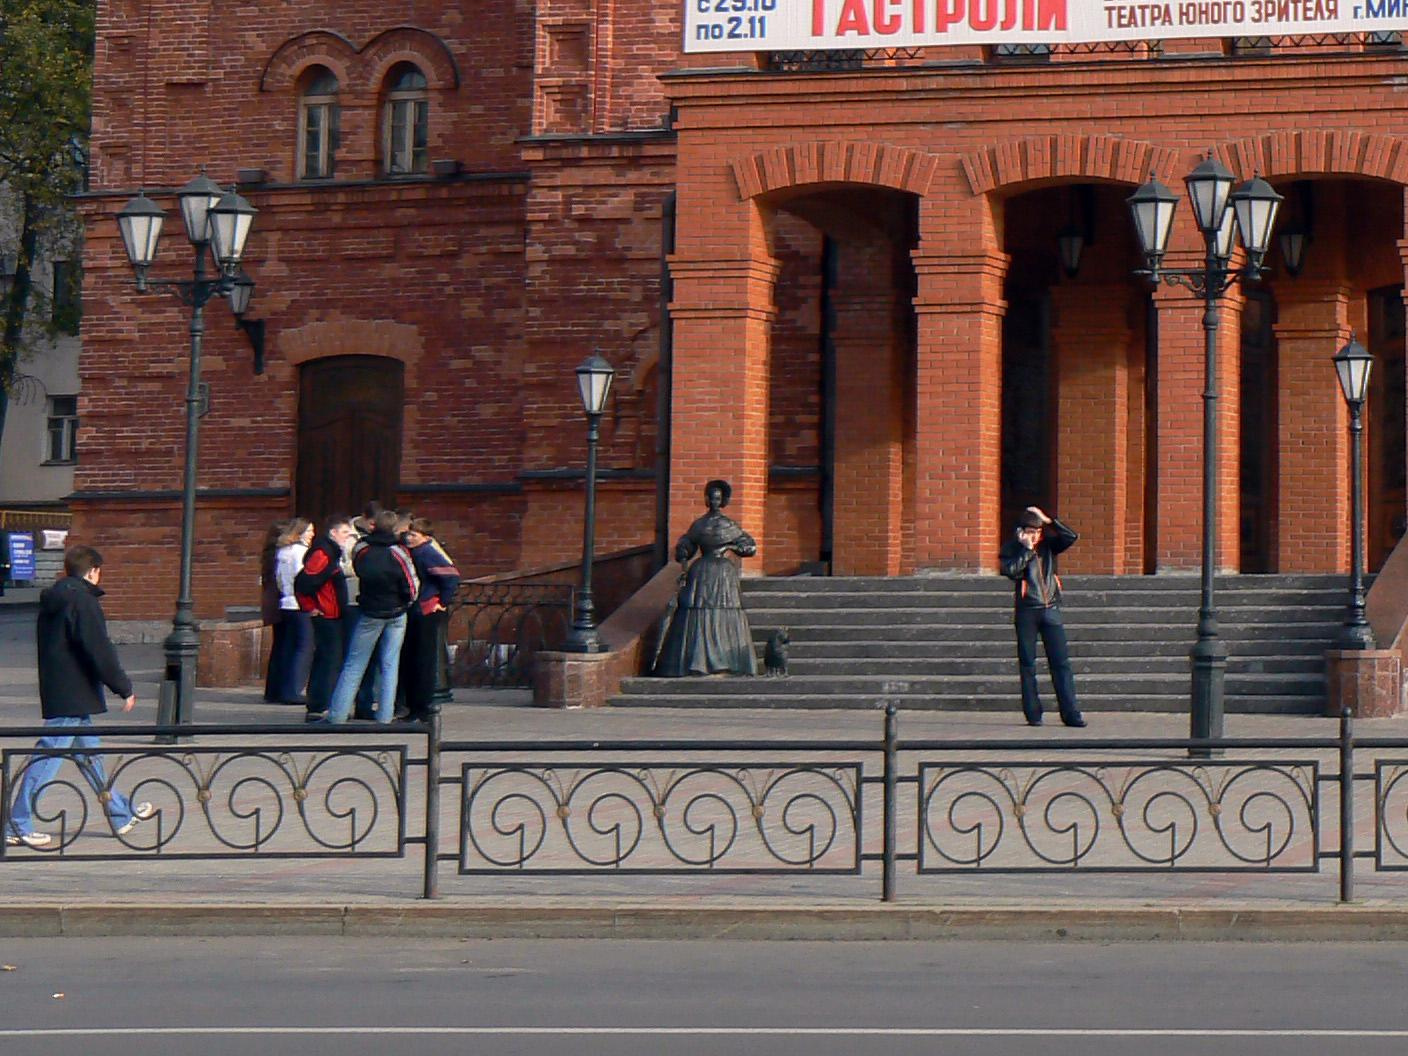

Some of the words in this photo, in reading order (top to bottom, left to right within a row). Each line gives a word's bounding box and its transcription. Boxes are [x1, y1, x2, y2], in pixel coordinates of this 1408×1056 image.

[1104, 4, 1173, 28] ТЕАТРА
[1178, 0, 1245, 25] ЮНОГО
[696, 24, 723, 40] по
[727, 16, 766, 39] 2.11
